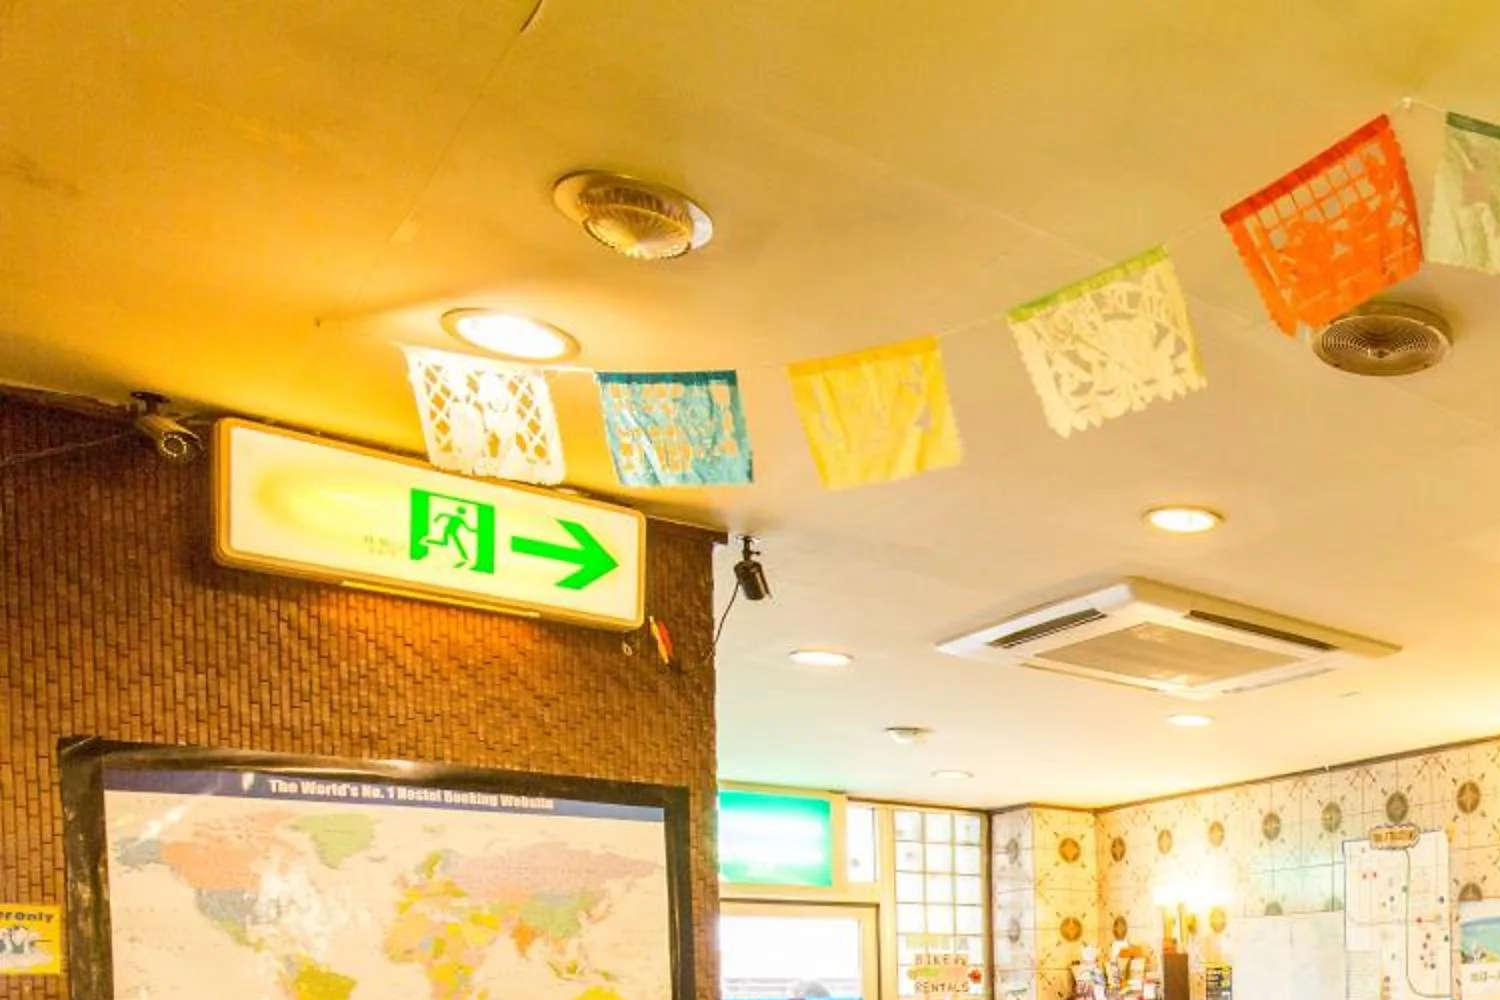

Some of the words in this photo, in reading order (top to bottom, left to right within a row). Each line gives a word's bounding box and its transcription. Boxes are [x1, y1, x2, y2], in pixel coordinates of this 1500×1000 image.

[271, 779, 298, 793] The
[300, 781, 359, 797] World's
[362, 784, 385, 798] No.
[387, 786, 395, 799] 1
[397, 786, 442, 801] Hostel
